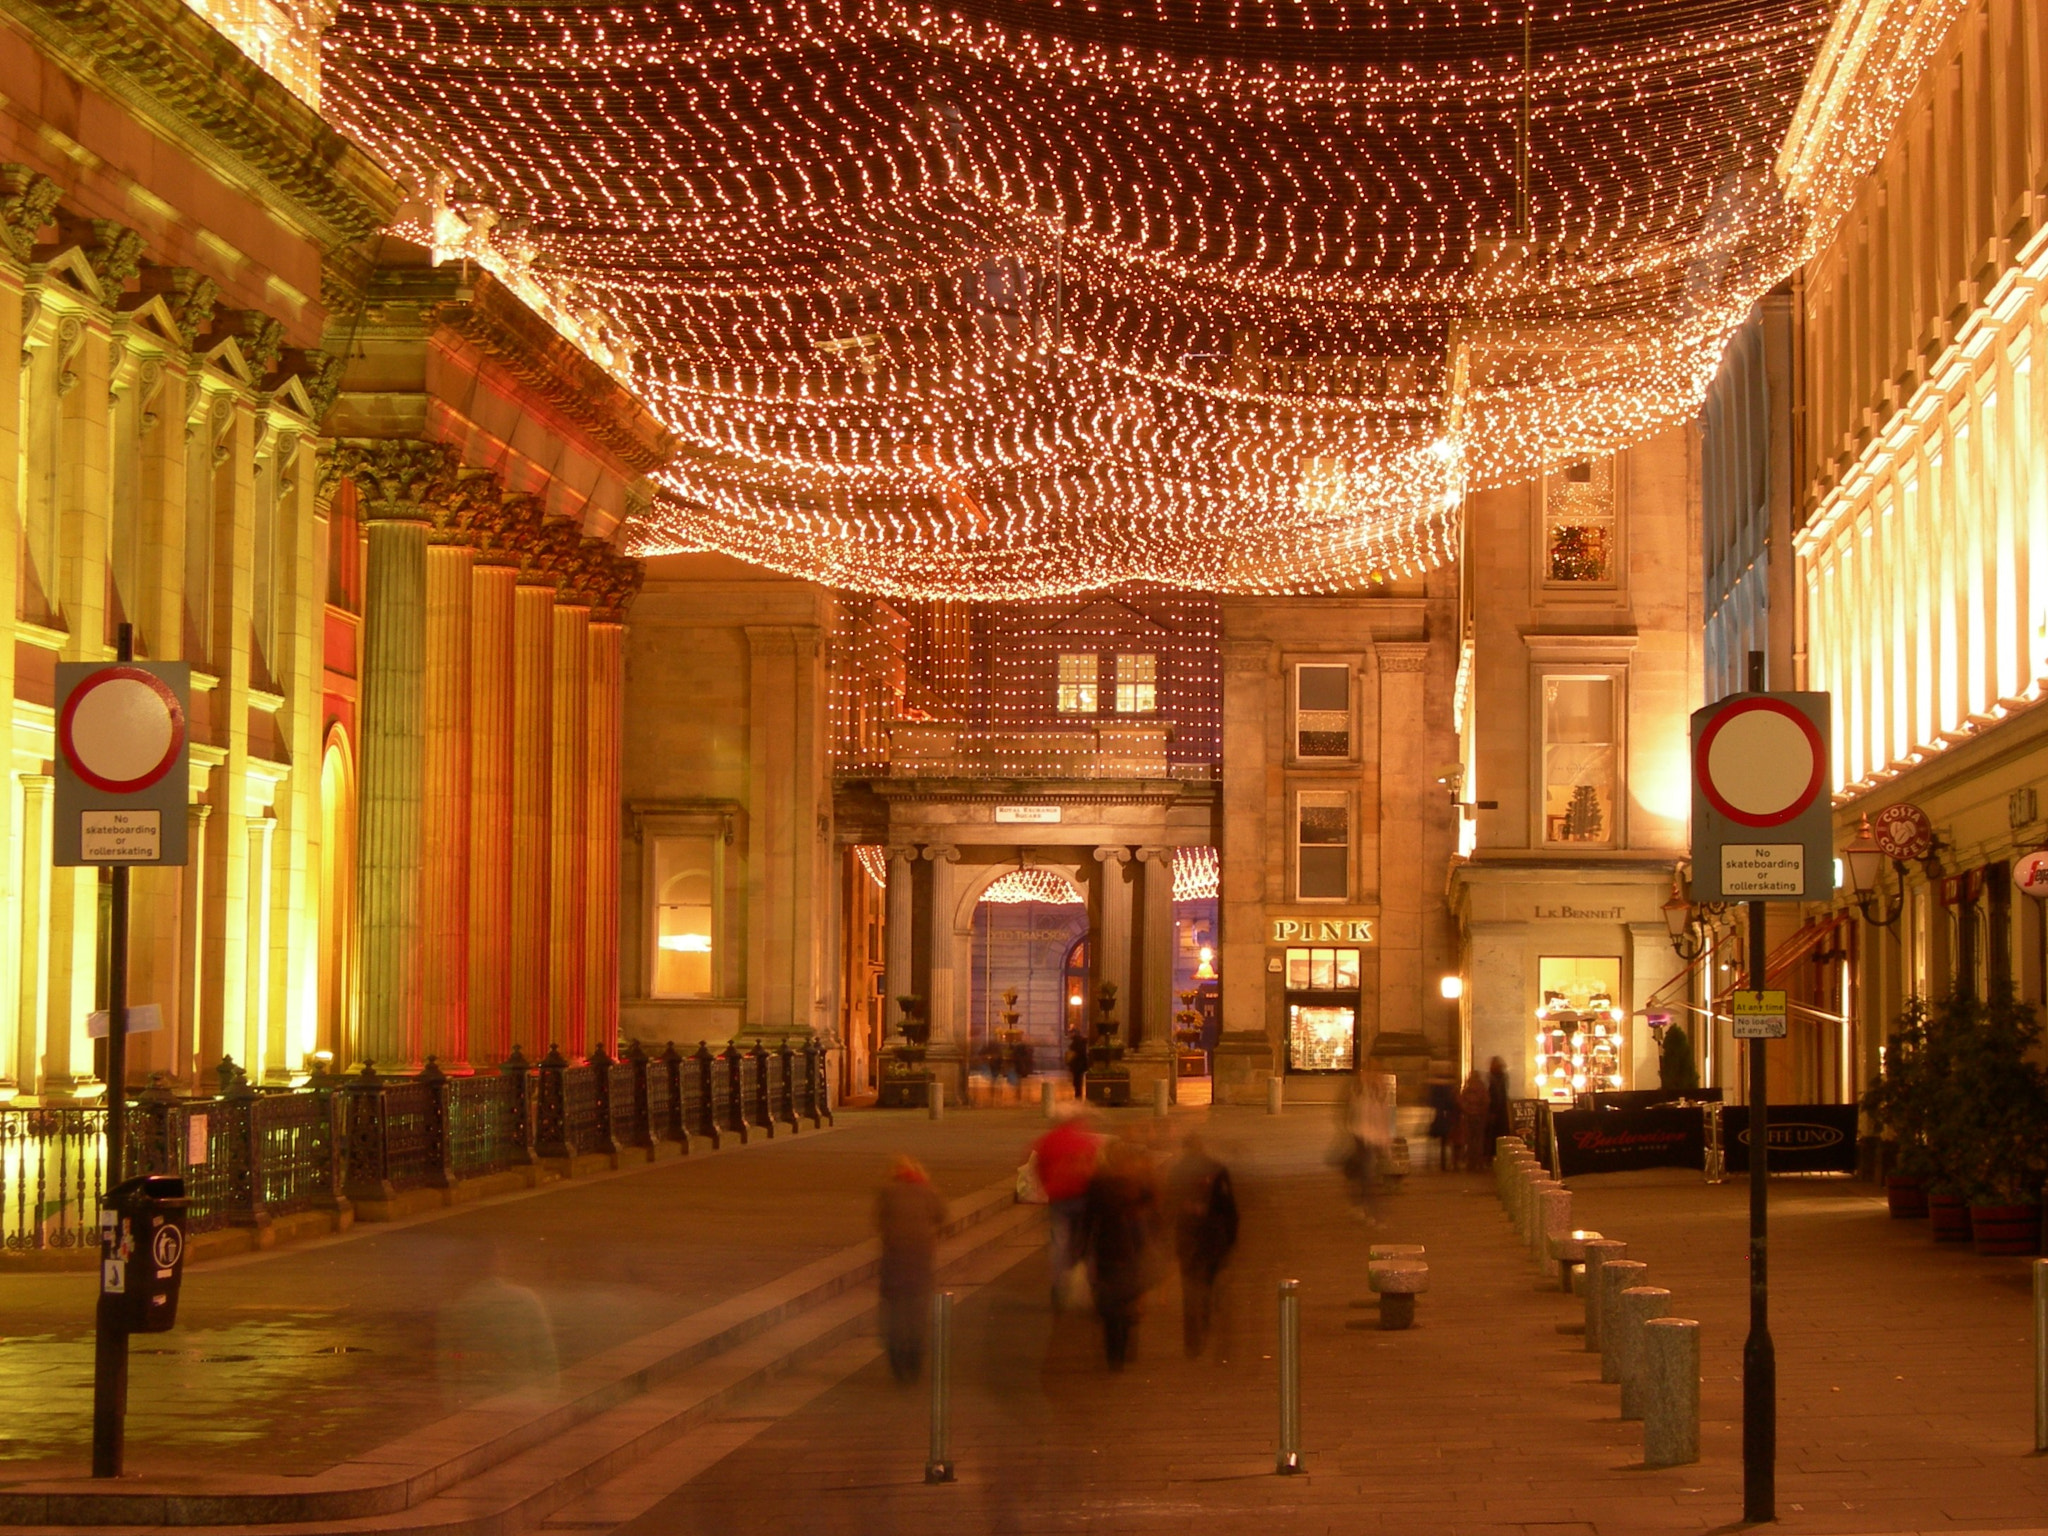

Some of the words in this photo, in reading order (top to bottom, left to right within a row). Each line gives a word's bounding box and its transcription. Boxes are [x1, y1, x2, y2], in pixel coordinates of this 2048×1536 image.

[114, 815, 129, 823] No
[1883, 807, 1921, 822] COSTA
[86, 825, 156, 835] skateboarding
[115, 837, 126, 845] or
[89, 846, 153, 856] rollerskating
[1880, 837, 1926, 856] COFFEE
[1755, 848, 1771, 857] No
[1726, 860, 1800, 870] skateboarding
[1730, 881, 1796, 891] rollerskating
[1273, 920, 1374, 942] PINK
[1572, 1130, 1688, 1149] Budweiser
[1797, 1130, 1836, 1141] UNO
